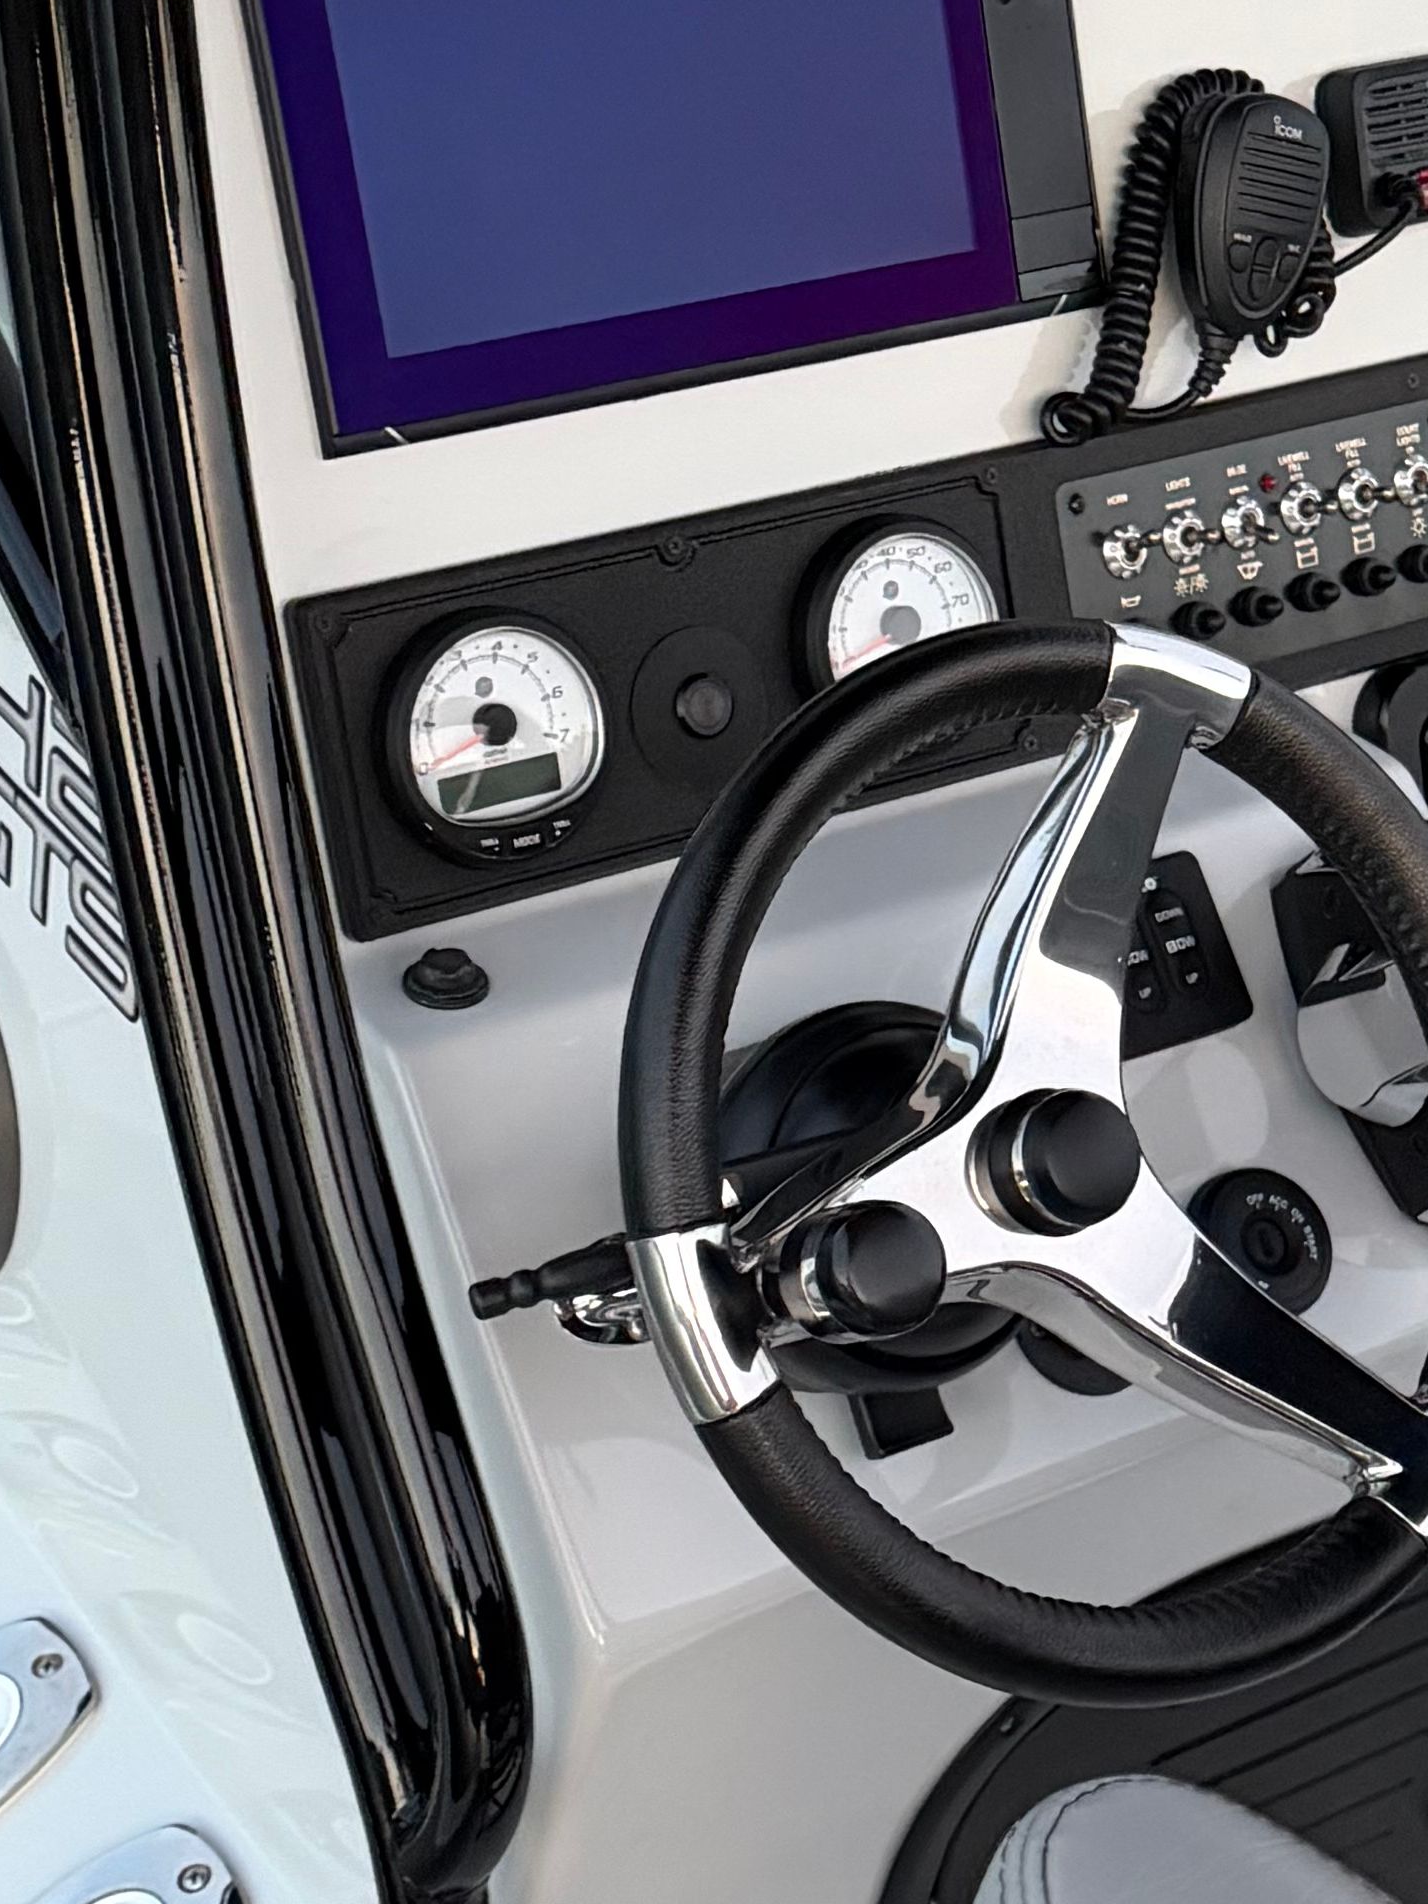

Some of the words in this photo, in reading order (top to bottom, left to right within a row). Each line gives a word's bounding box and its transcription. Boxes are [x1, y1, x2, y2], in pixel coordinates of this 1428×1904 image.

[952, 593, 970, 607] 70
[551, 685, 564, 698] 6
[559, 729, 570, 743] 7
[1154, 907, 1184, 923] DOWN
